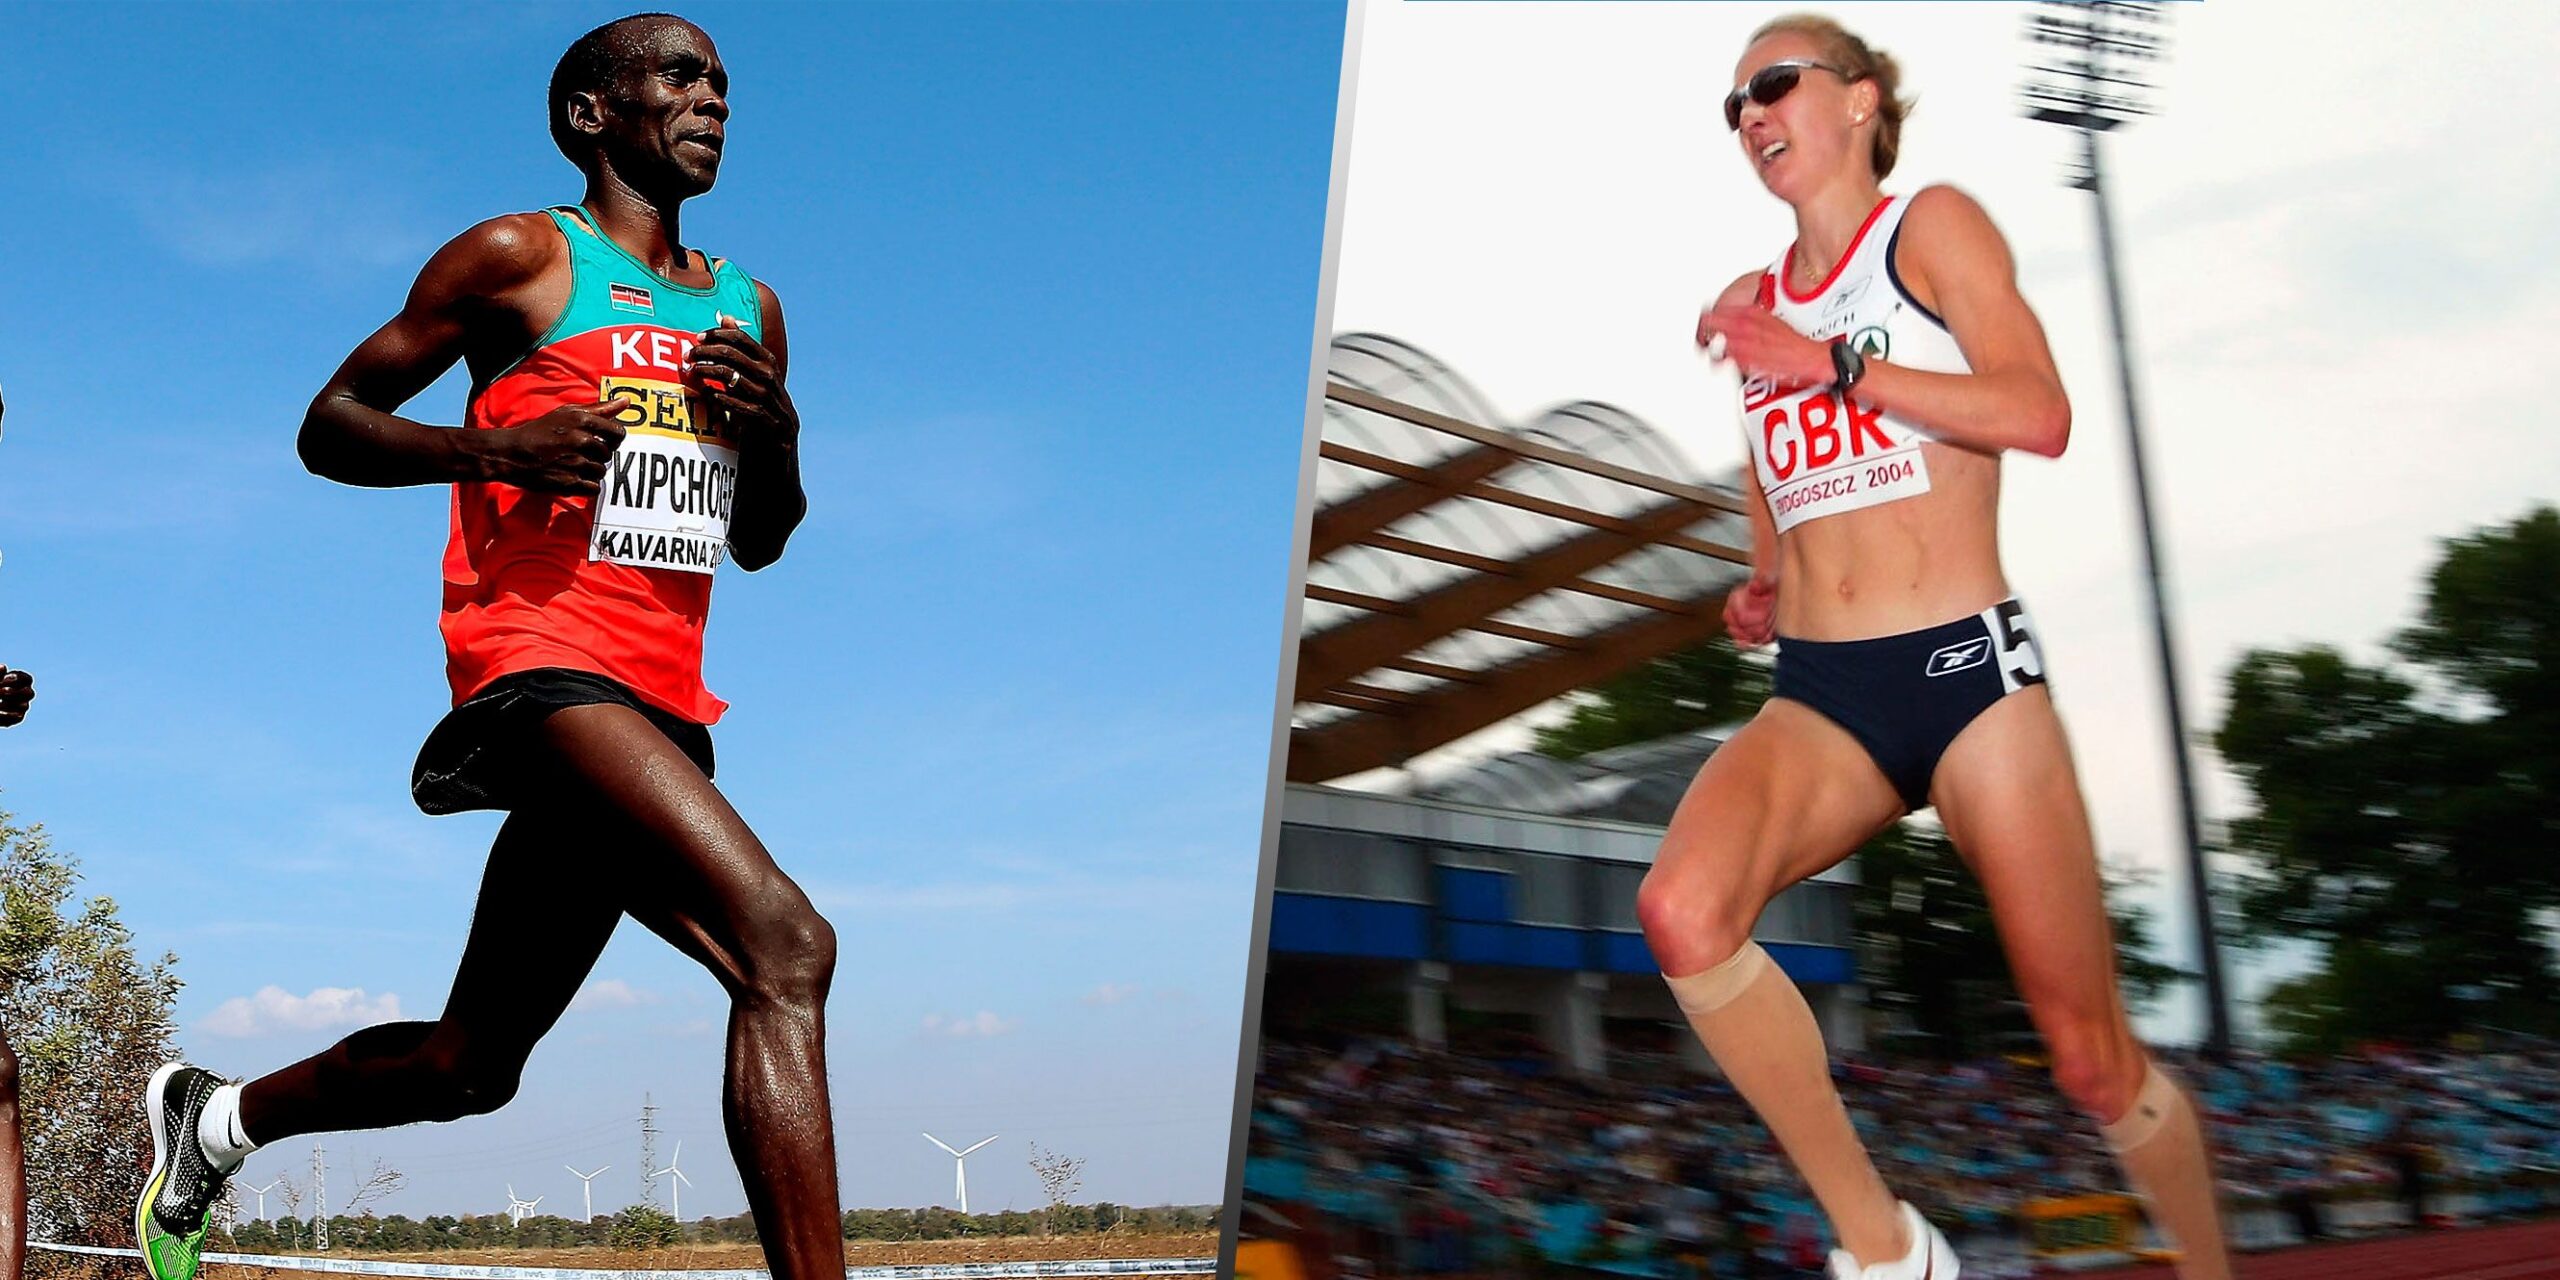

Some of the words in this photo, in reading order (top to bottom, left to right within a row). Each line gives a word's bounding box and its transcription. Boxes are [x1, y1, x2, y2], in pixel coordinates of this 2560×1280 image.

[1866, 460, 1914, 488] 2004
[600, 530, 707, 567] KAVARNA
[1996, 600, 2045, 687] 5
